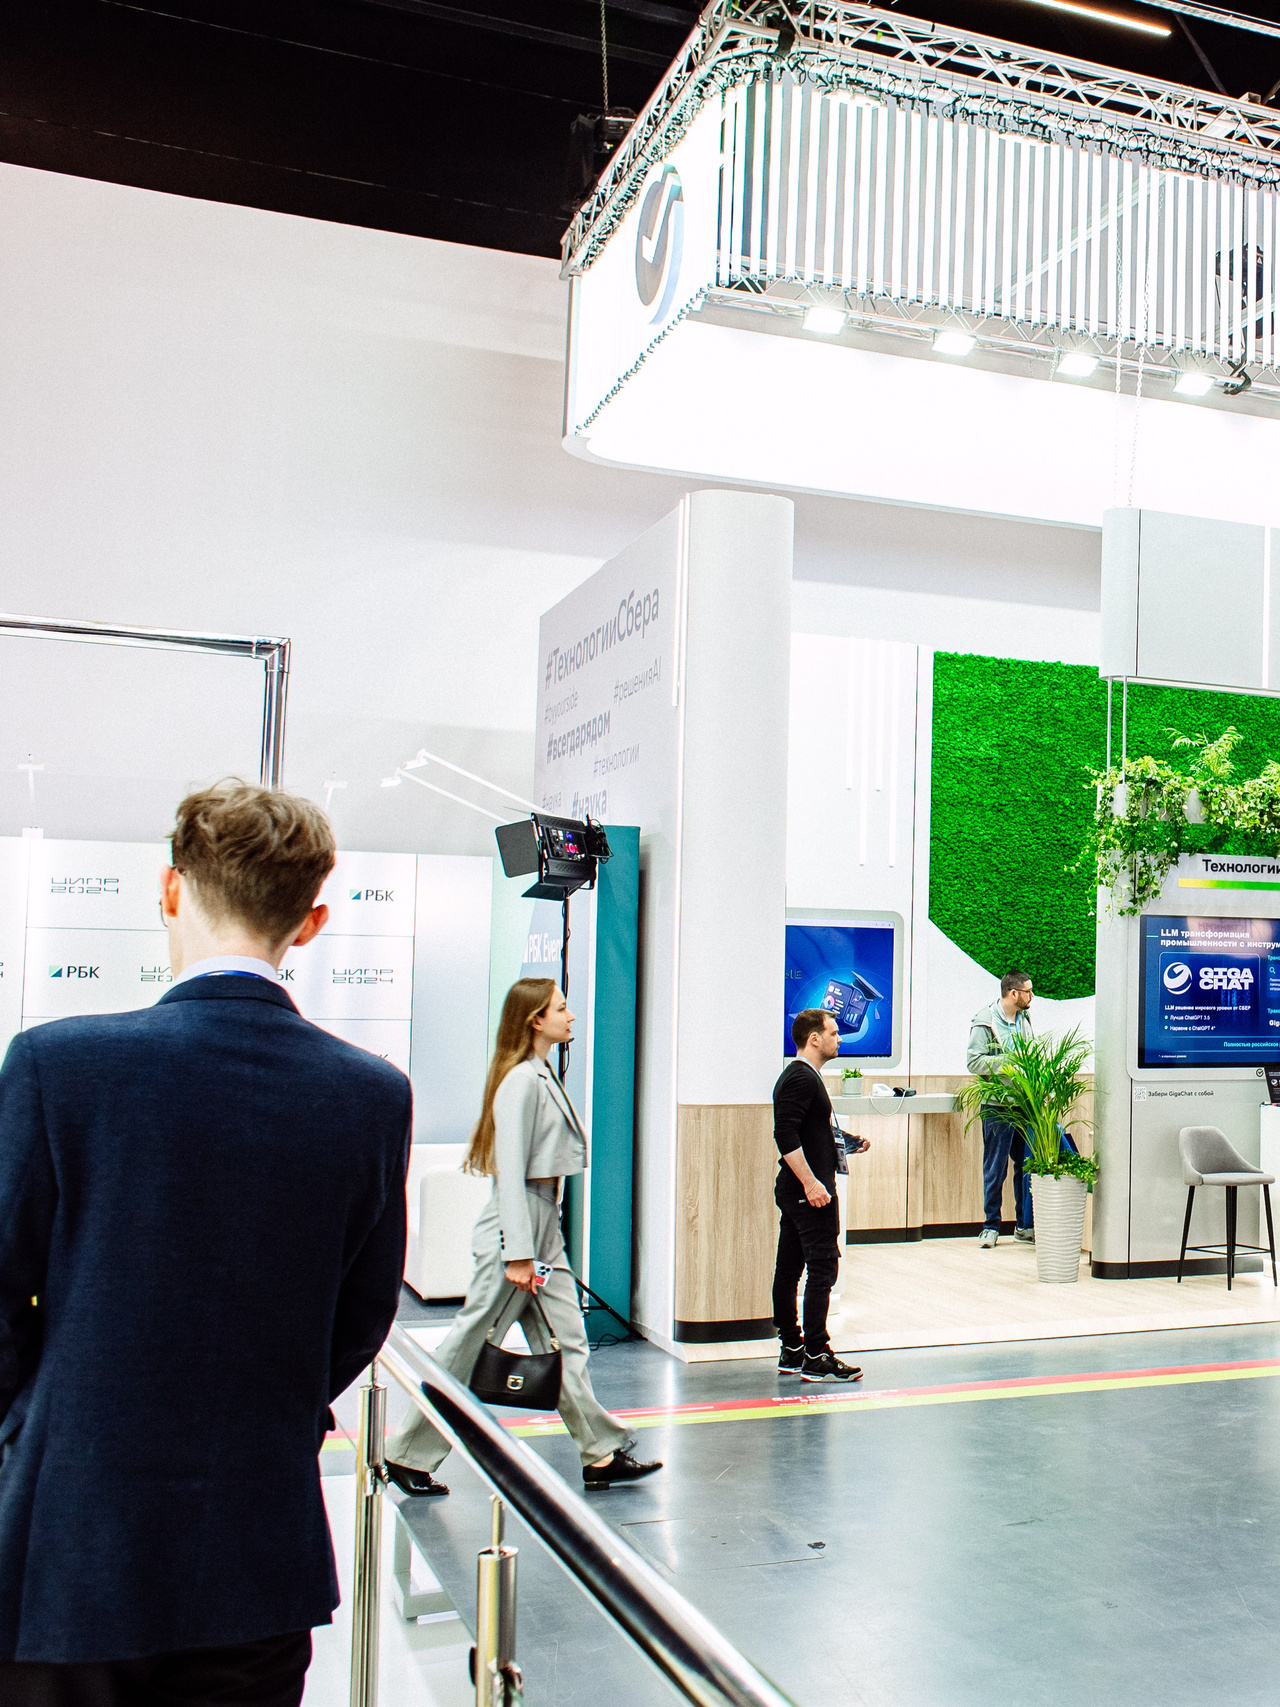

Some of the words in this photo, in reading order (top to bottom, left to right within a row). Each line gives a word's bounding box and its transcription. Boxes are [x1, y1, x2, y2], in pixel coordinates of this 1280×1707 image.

[544, 588, 660, 692] #ТехнологииСбера
[546, 710, 611, 765] #всегдарядом
[593, 744, 641, 780] #технологии
[571, 789, 608, 820] #наука
[365, 890, 394, 902] РБК
[1160, 928, 1179, 937] LLM
[1181, 930, 1250, 940] трансформация
[1160, 939, 1238, 947] промышленности
[67, 966, 100, 979] РБК
[277, 969, 295, 981] БК
[1199, 967, 1254, 980] GIGA
[1199, 978, 1254, 990] CHAT
